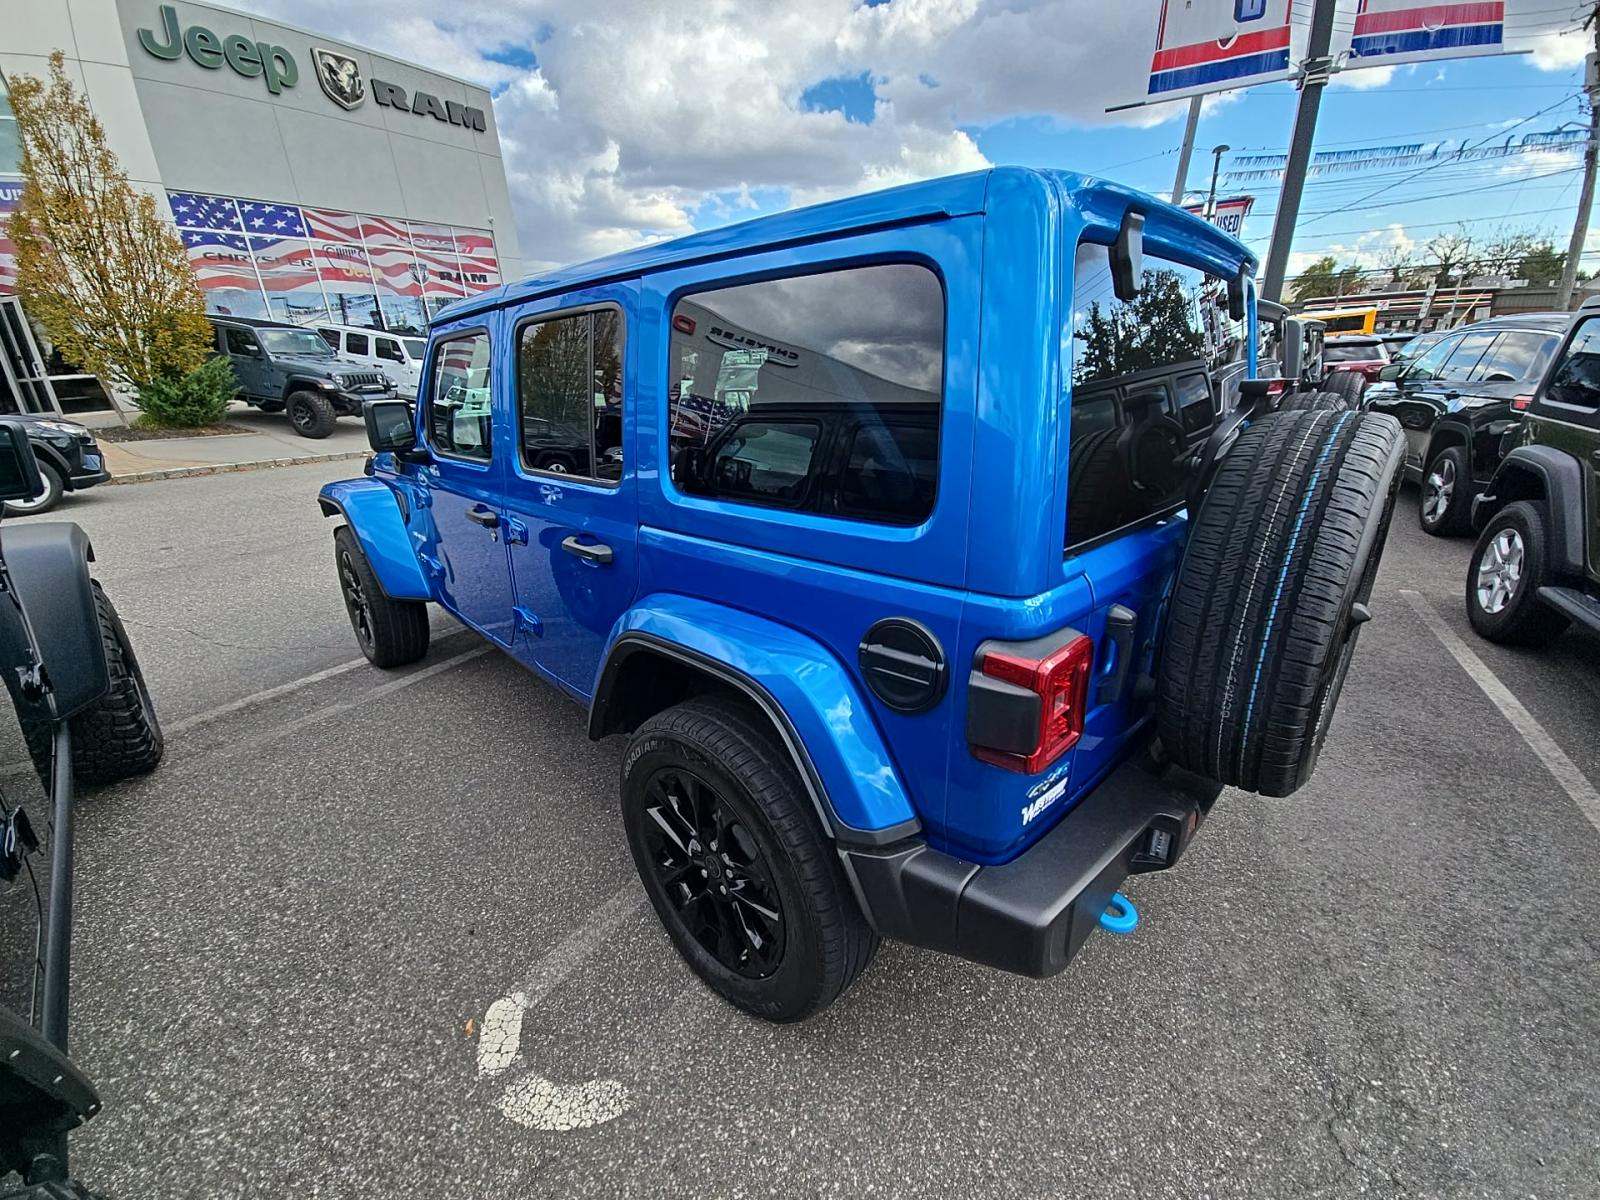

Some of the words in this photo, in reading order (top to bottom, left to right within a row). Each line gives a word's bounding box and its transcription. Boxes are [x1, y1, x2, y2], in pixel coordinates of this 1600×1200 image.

[137, 4, 299, 95] Jeep
[370, 77, 486, 132] RAM
[1216, 213, 1240, 232] USED
[439, 271, 488, 283] RAM
